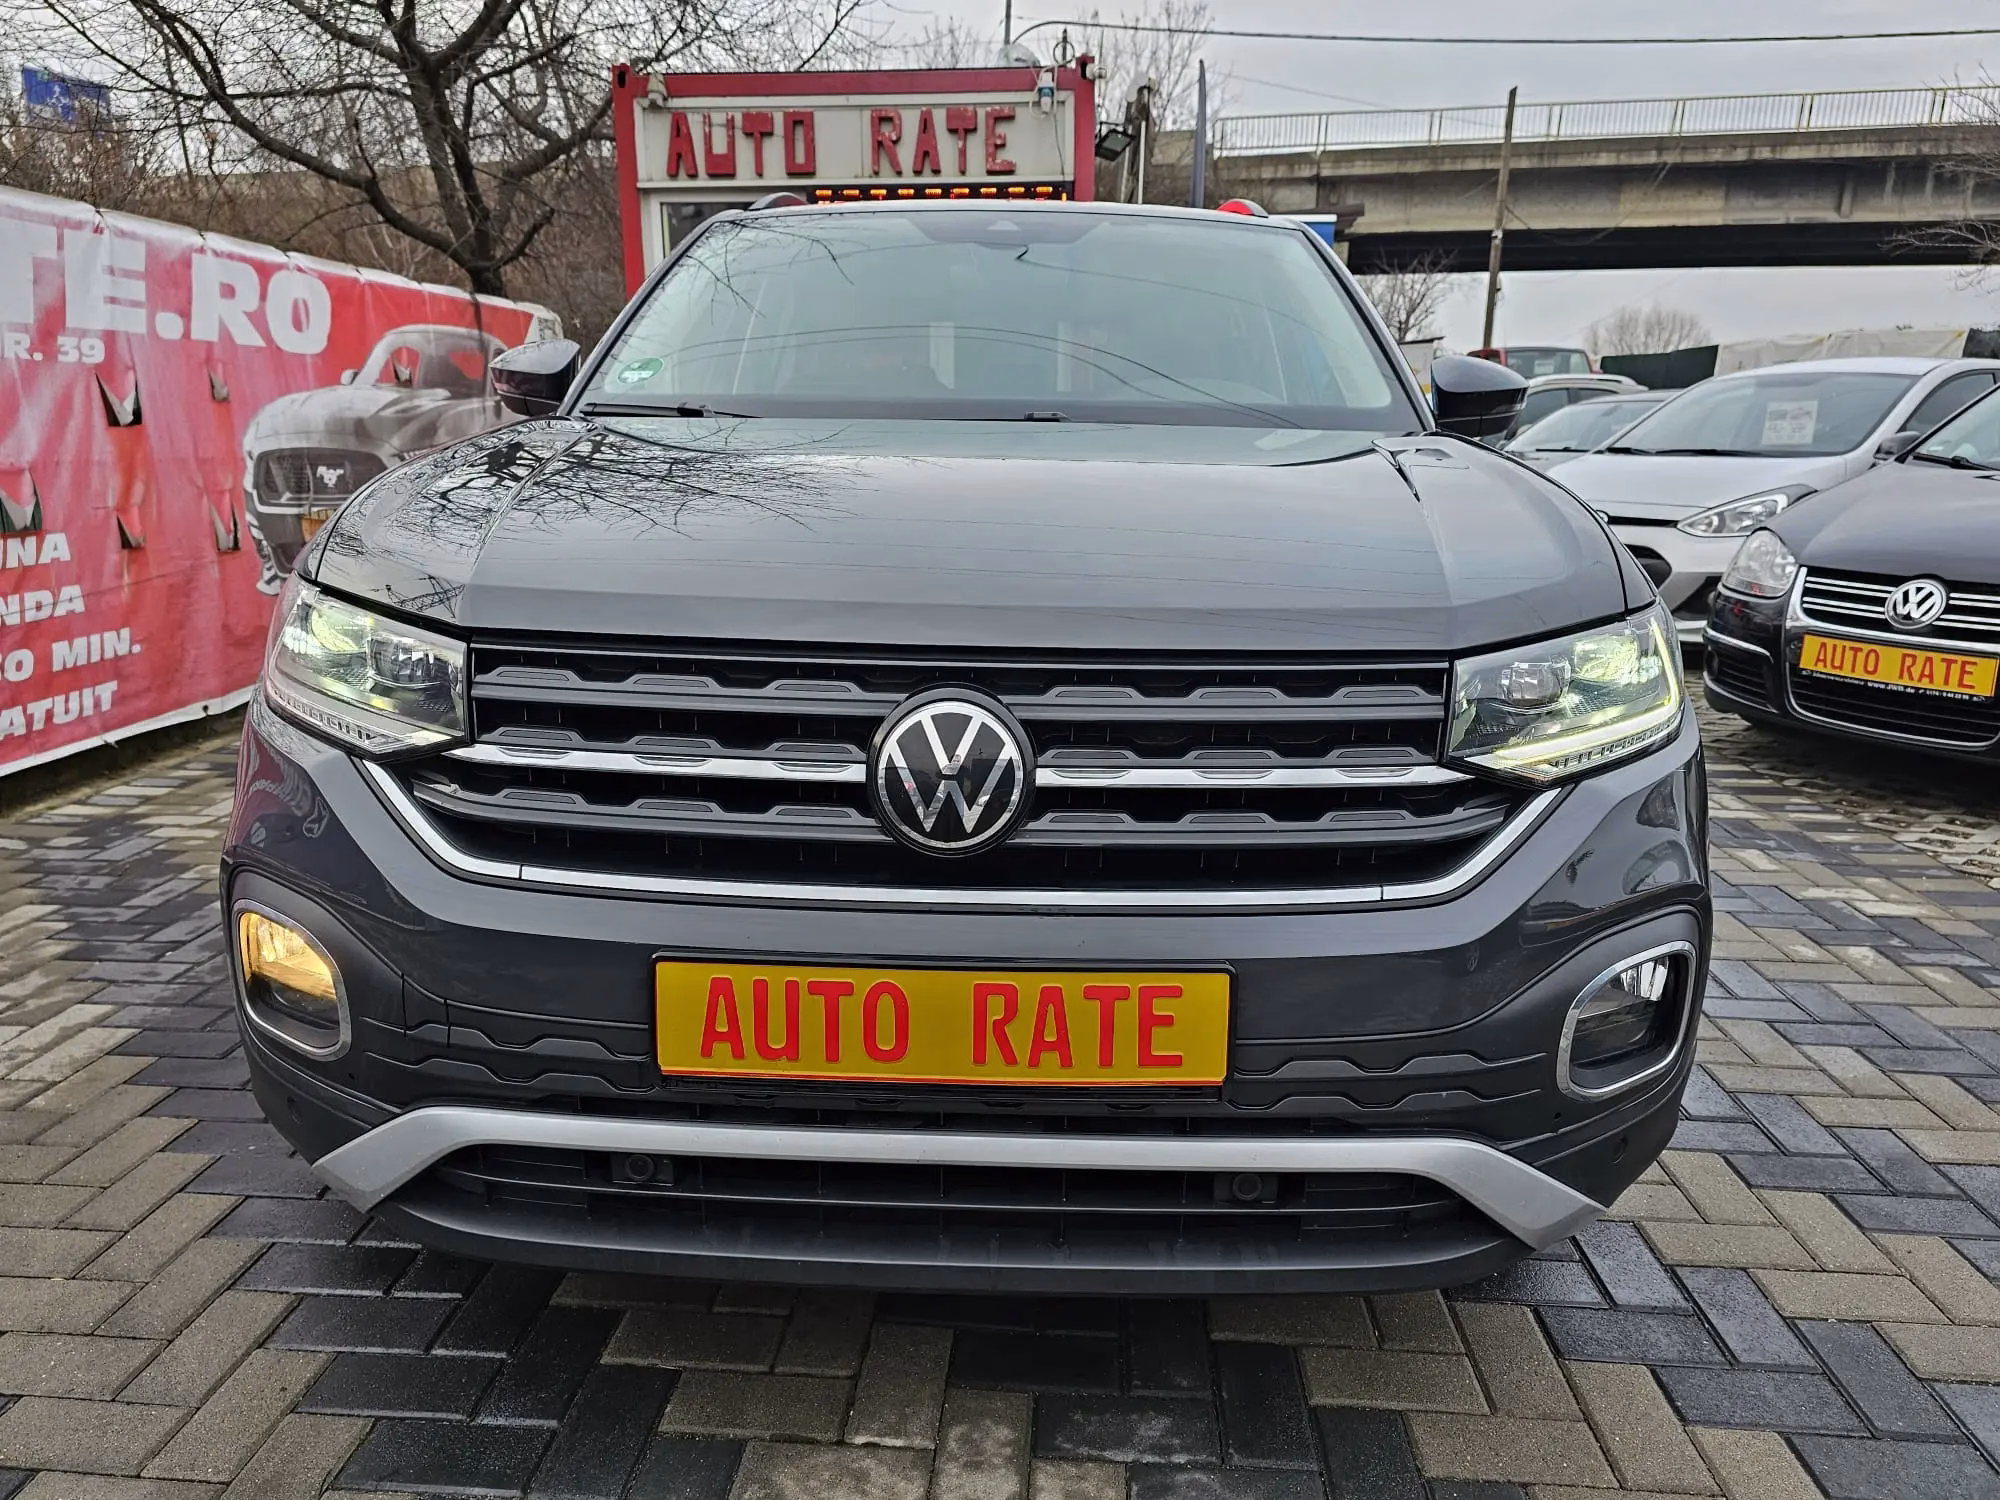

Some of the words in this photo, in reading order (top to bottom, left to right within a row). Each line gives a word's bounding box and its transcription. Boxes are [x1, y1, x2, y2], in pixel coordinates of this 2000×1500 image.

[666, 110, 816, 178] AUTO
[870, 106, 1018, 176] RATE
[57, 335, 106, 364] 39
[0, 533, 71, 570] NA
[52, 627, 142, 672] MIN.
[1814, 641, 1881, 676] AUTO
[1898, 652, 1978, 690] RATE
[700, 976, 910, 1063] AUTO
[971, 981, 1184, 1069] RATE
